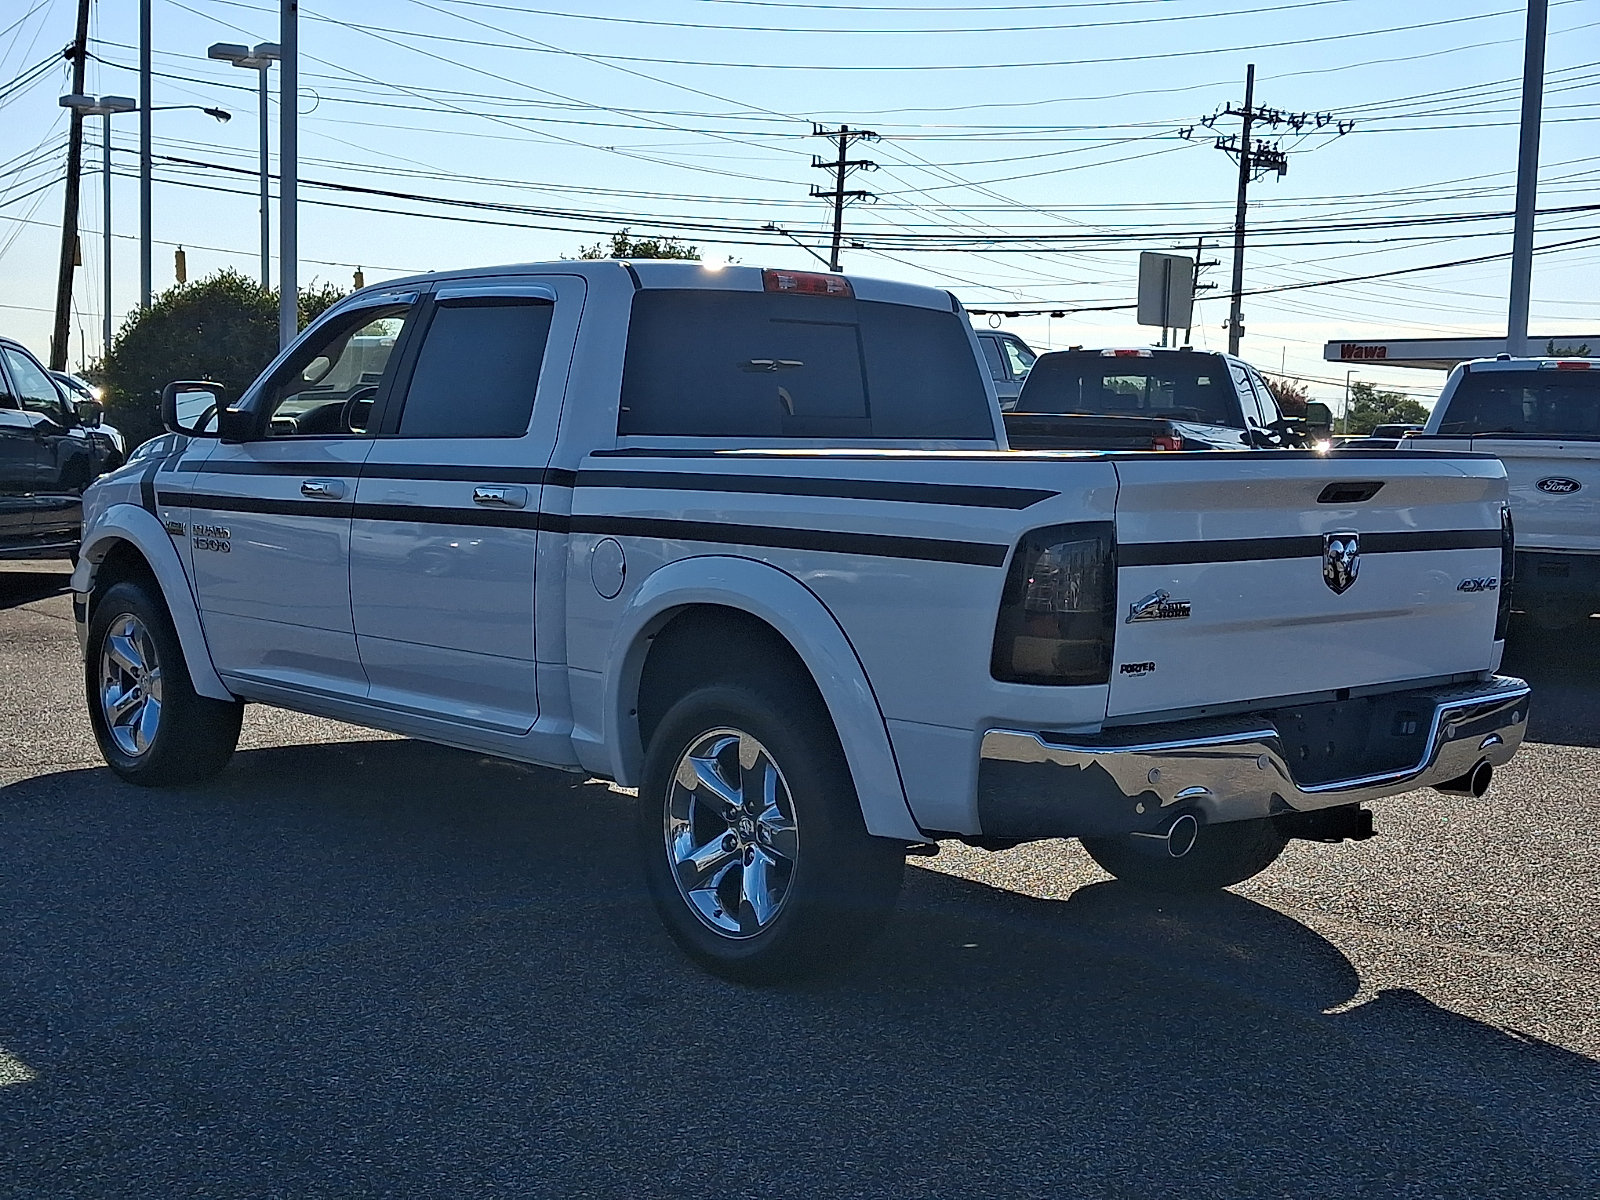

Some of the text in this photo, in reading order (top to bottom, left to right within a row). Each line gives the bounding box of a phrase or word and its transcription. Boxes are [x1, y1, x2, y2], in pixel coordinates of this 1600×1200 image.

[1341, 344, 1387, 359] Wawa
[1543, 479, 1573, 491] Ford
[193, 537, 231, 553] 1500
[1119, 661, 1156, 674] PORTER
